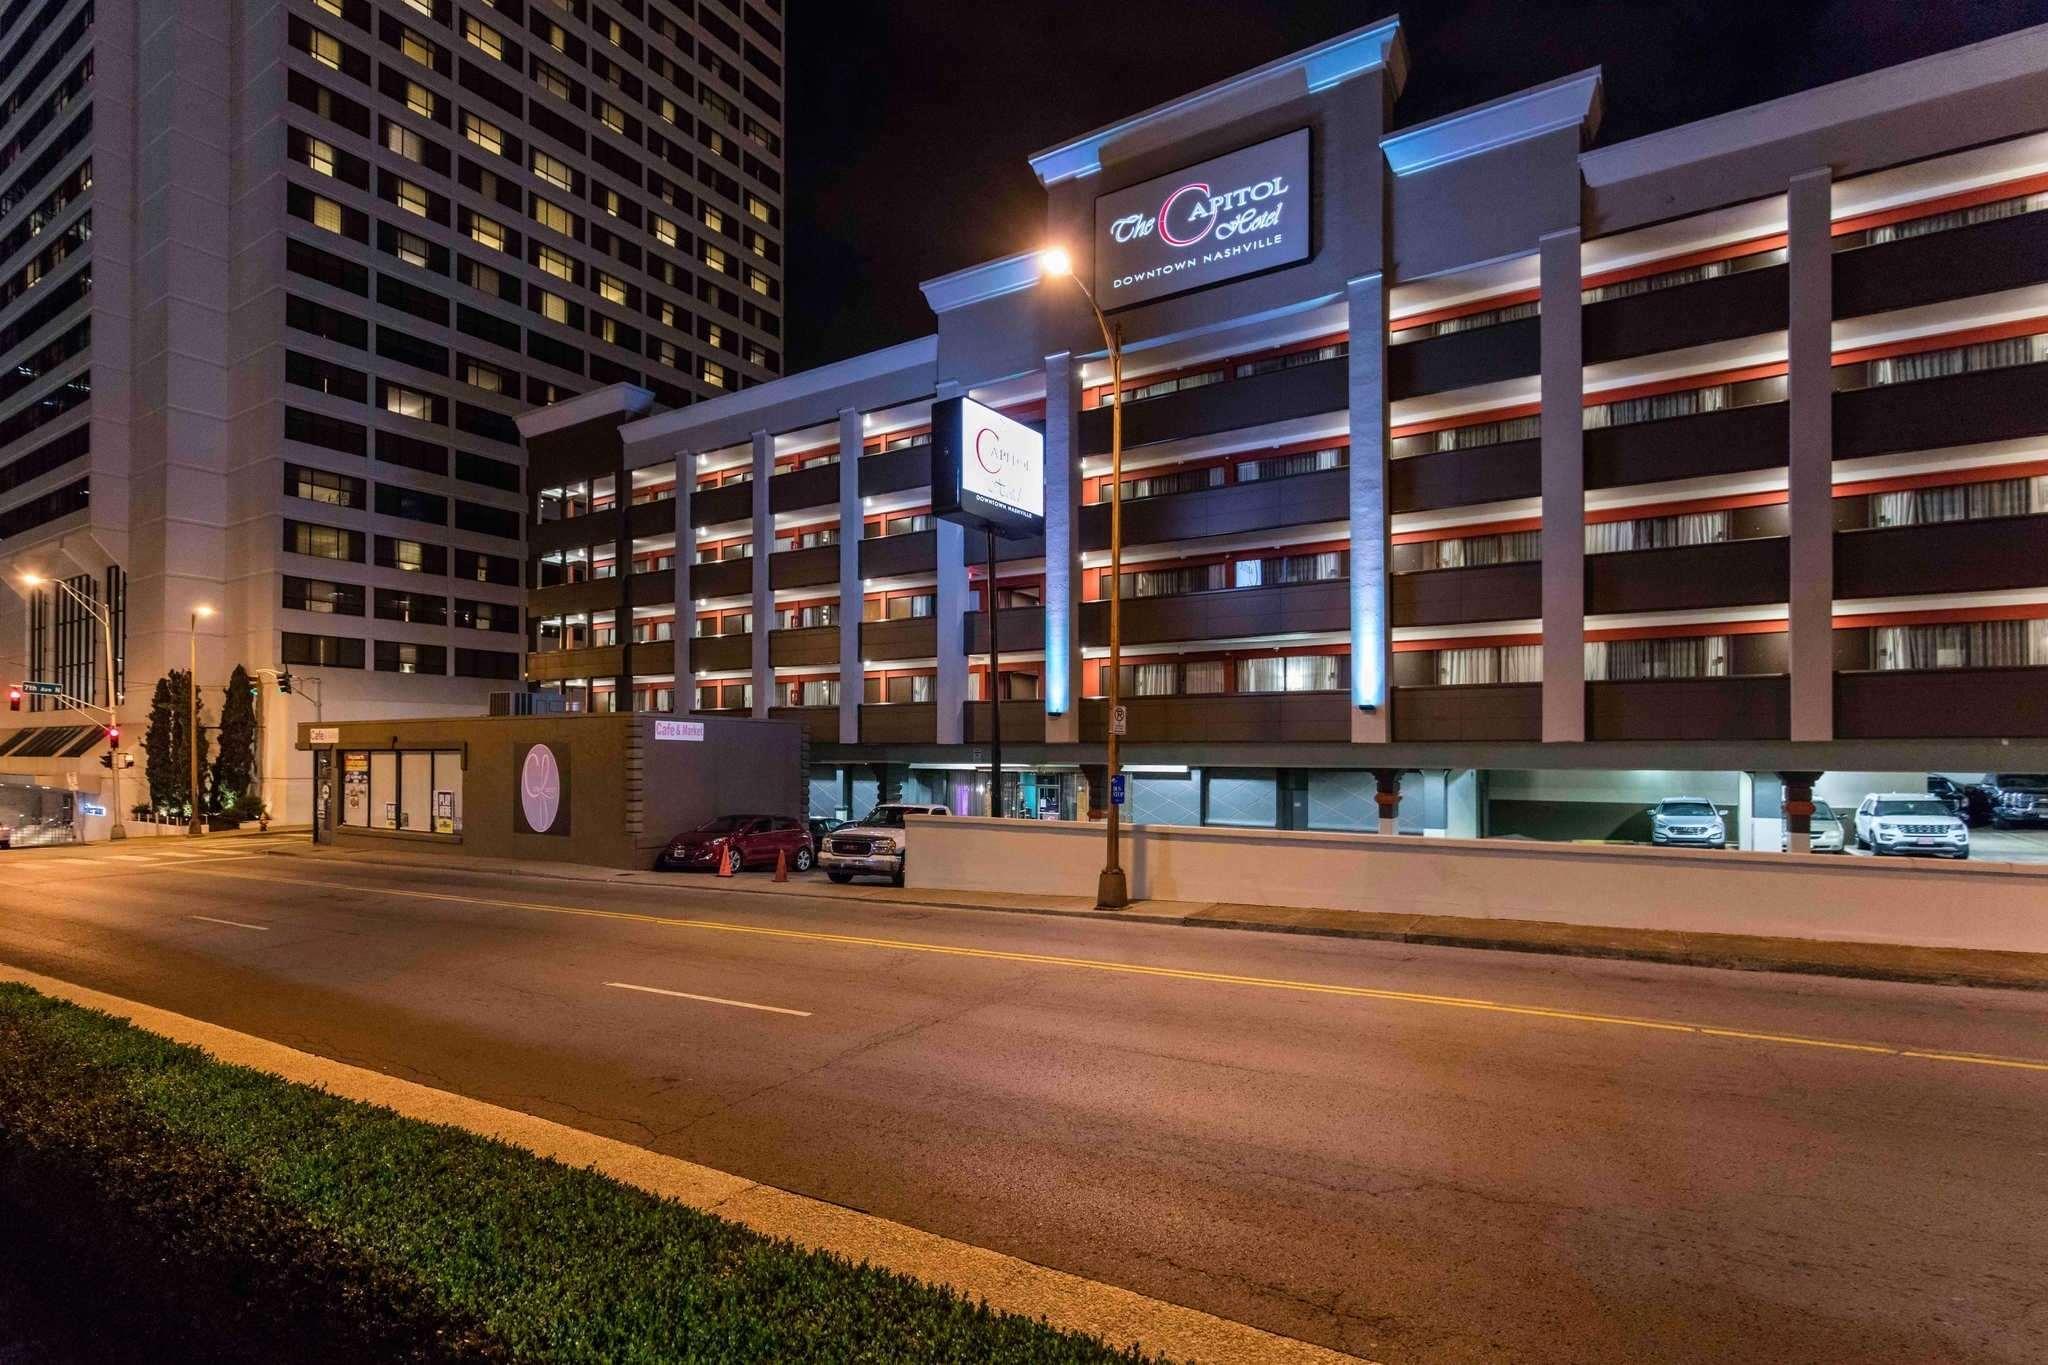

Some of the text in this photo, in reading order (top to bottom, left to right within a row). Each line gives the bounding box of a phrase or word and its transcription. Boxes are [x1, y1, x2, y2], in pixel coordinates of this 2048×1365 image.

[1110, 176, 1289, 247] The CAPITOL
[1215, 202, 1284, 241] Hotel
[1113, 234, 1283, 288] DOWNTOWN NASHVILLE
[976, 494, 1032, 519] DOWNTOWN NASHVILLE
[656, 722, 674, 736] Cafe
